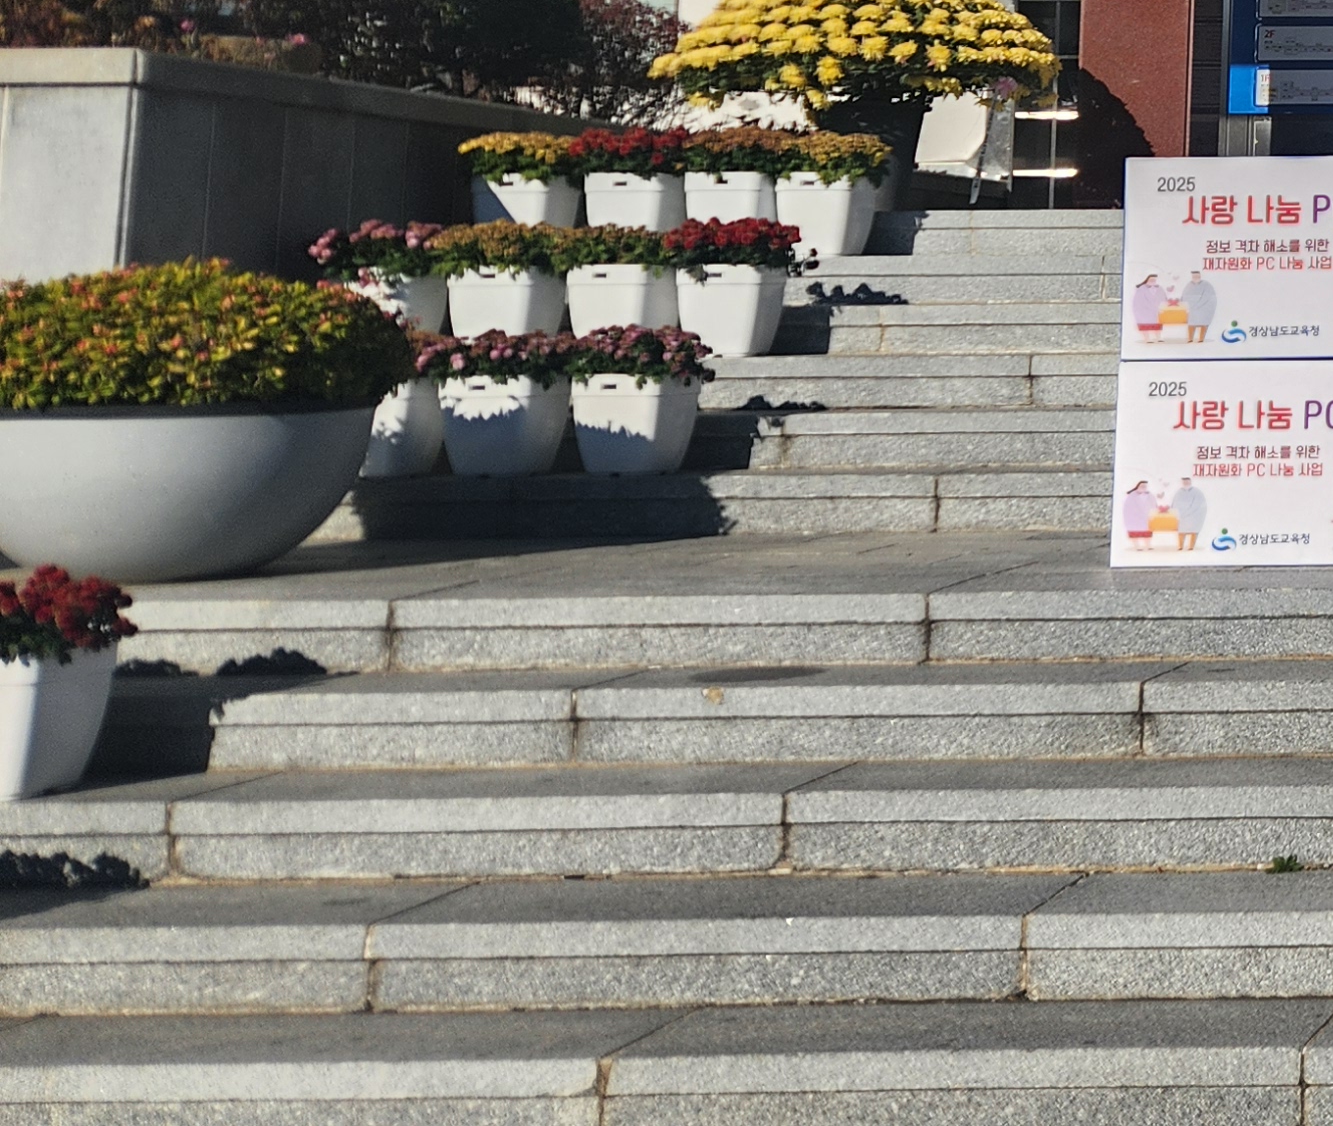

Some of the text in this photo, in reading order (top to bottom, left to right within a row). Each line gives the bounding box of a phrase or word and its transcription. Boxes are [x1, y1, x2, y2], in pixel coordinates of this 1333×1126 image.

[1264, 29, 1275, 39] 2F
[1157, 177, 1195, 192] 2025
[1182, 195, 1238, 225] 사랑
[1247, 195, 1301, 224] 나눔
[1206, 239, 1329, 254] 정보 격차 해소를 위한
[1203, 256, 1332, 270] 재자원화 PC 나눔 사업
[1249, 325, 1319, 337] 경상남도교육청
[1149, 382, 1187, 396] 2025
[1173, 401, 1229, 430] 사랑
[1238, 400, 1292, 430] 나눔
[1197, 445, 1320, 460] 정보 격차 해소를 위한
[1193, 463, 1323, 477] 재자원화 PC 나눔 사업
[1239, 533, 1310, 545] 경상남도교육청
